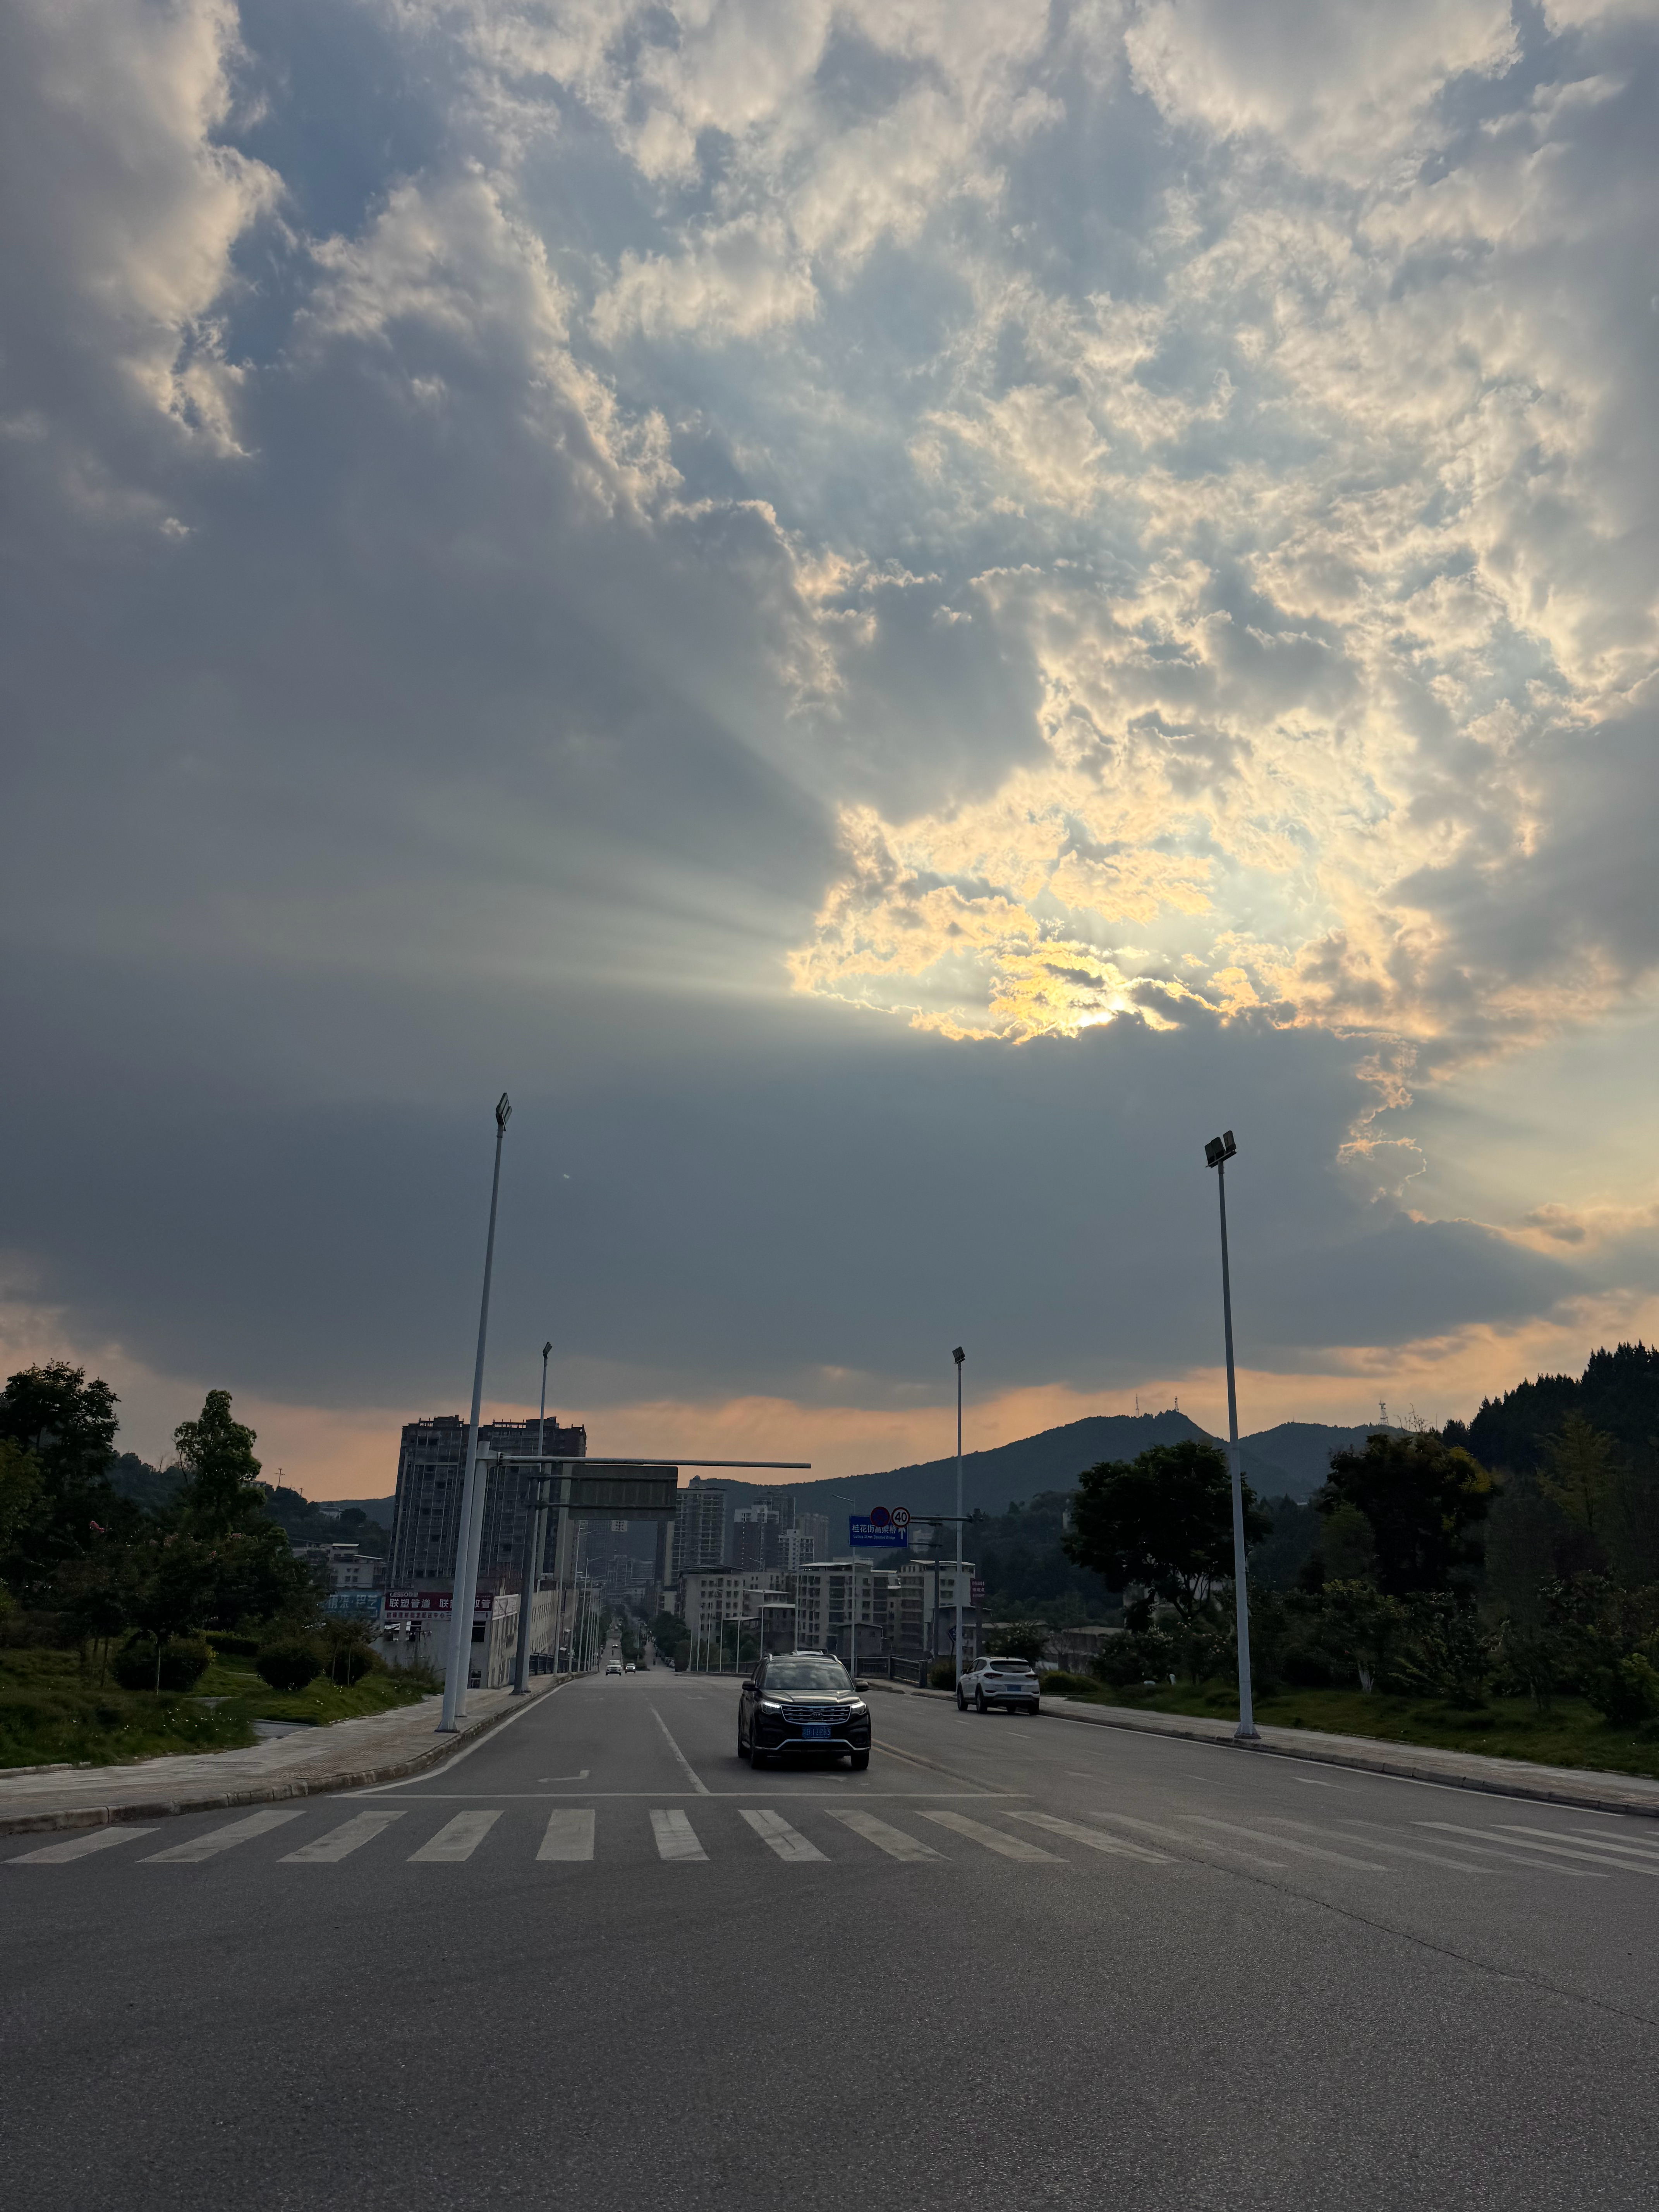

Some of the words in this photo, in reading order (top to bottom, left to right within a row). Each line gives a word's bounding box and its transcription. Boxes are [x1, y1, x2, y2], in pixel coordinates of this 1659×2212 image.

[895, 1512, 907, 1522] 40
[389, 1598, 430, 1608] 联塑管道
